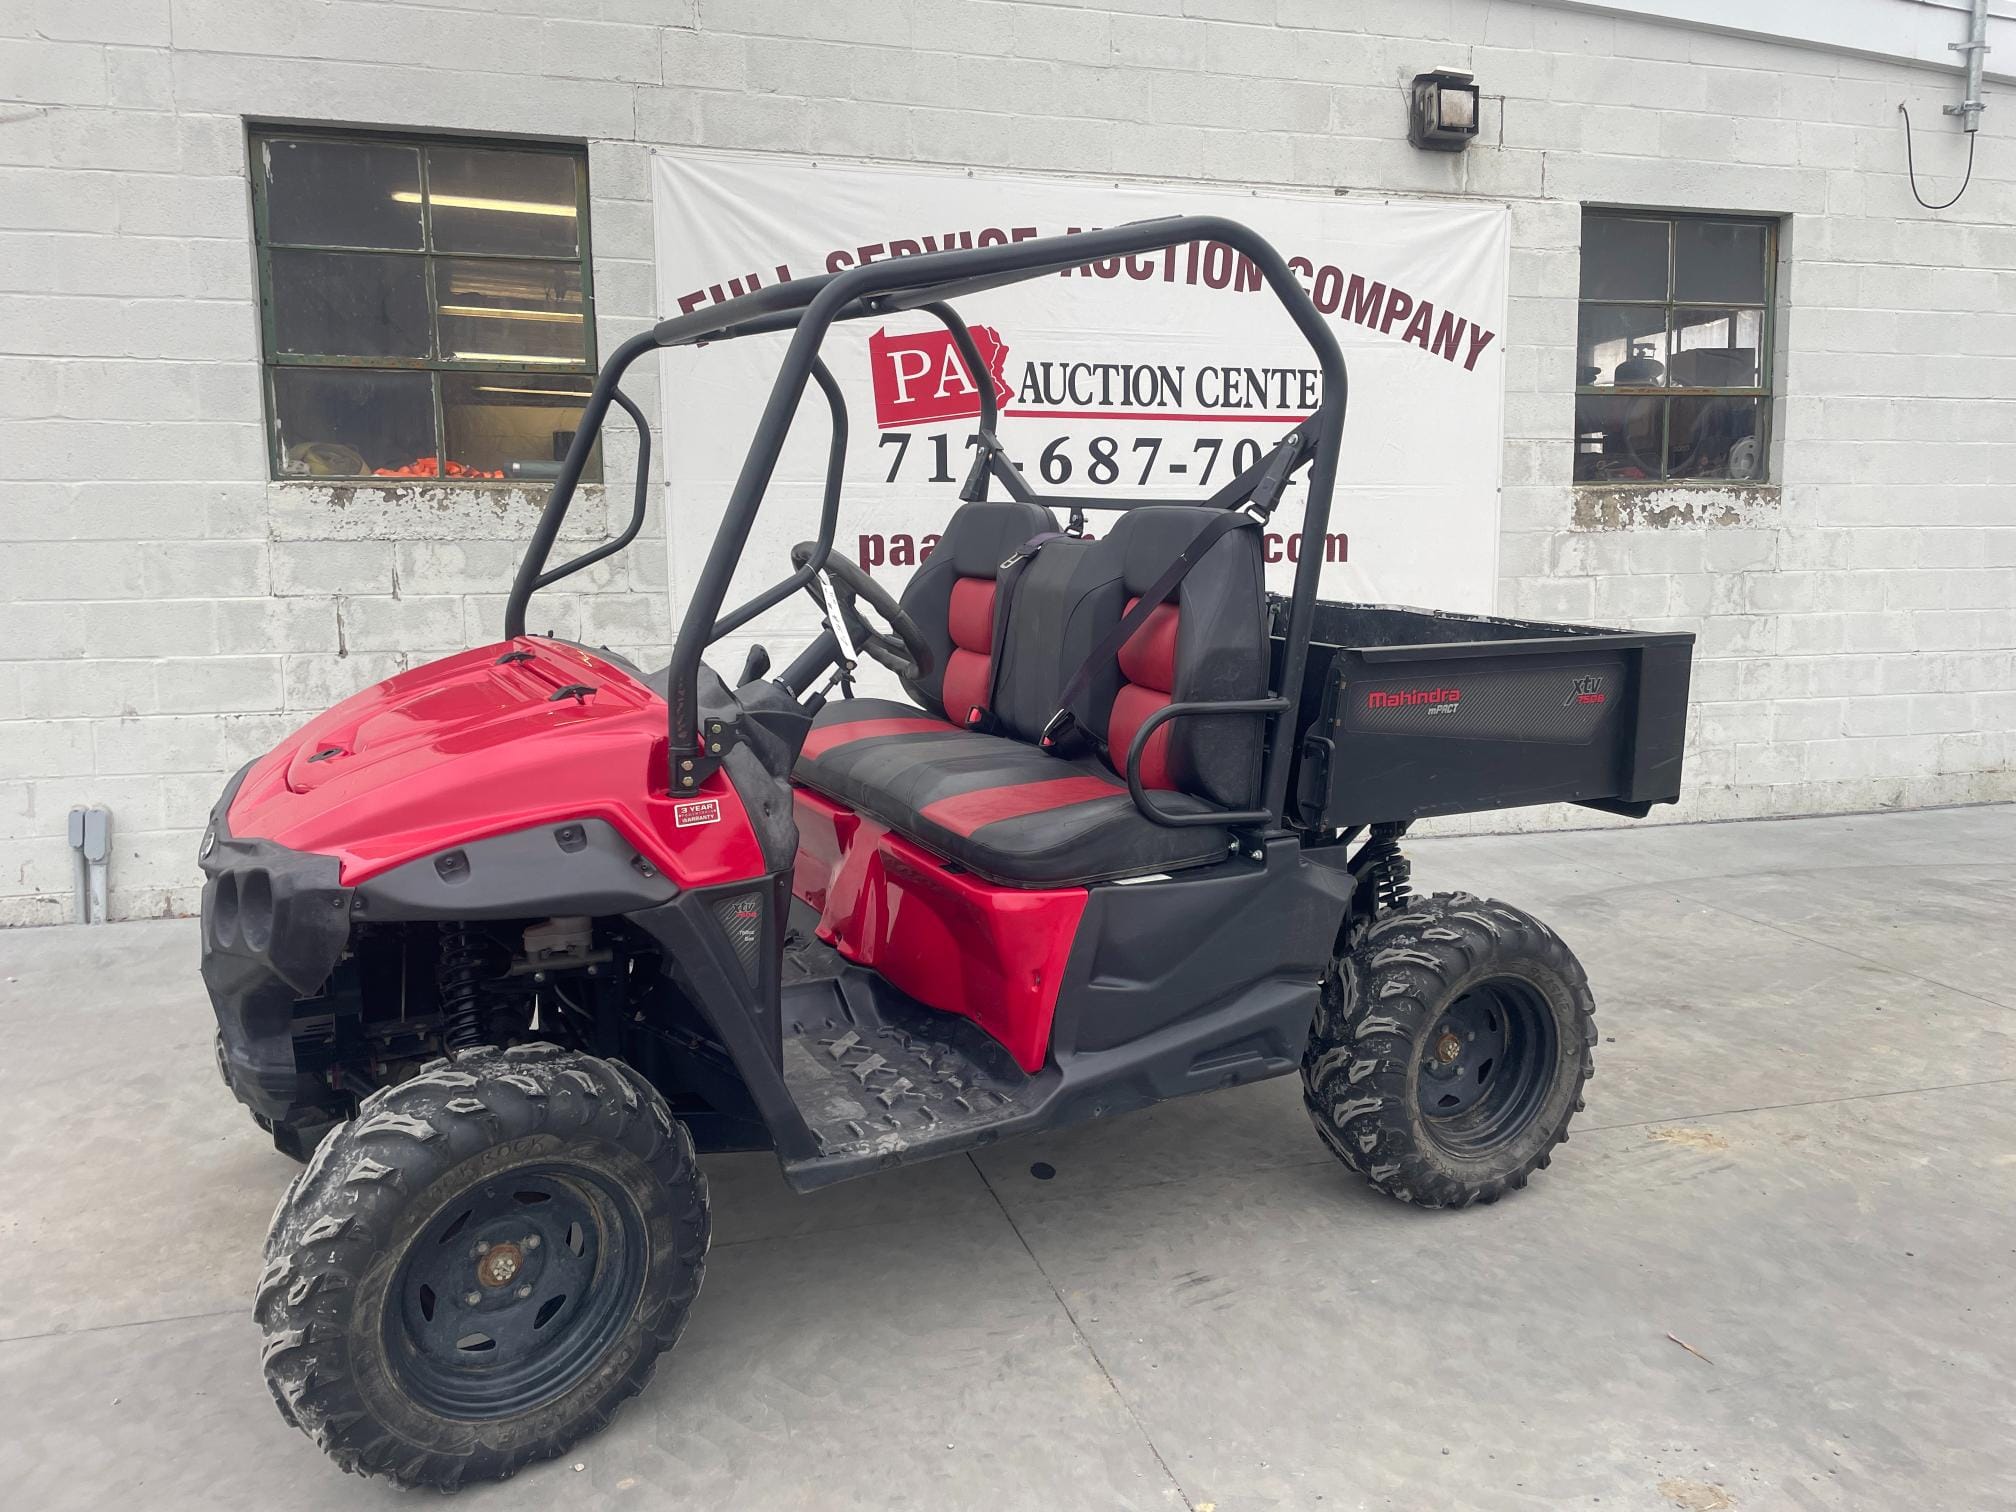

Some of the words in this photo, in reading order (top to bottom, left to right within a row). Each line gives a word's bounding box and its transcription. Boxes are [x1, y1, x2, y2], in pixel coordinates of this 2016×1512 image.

[886, 343, 979, 405] PA
[1017, 361, 1186, 408] AUCTION
[1195, 366, 1325, 410] CENTE
[1368, 687, 1461, 709] Mahindra
[690, 803, 713, 812] YEAR
[682, 814, 716, 823] WARRANTY
